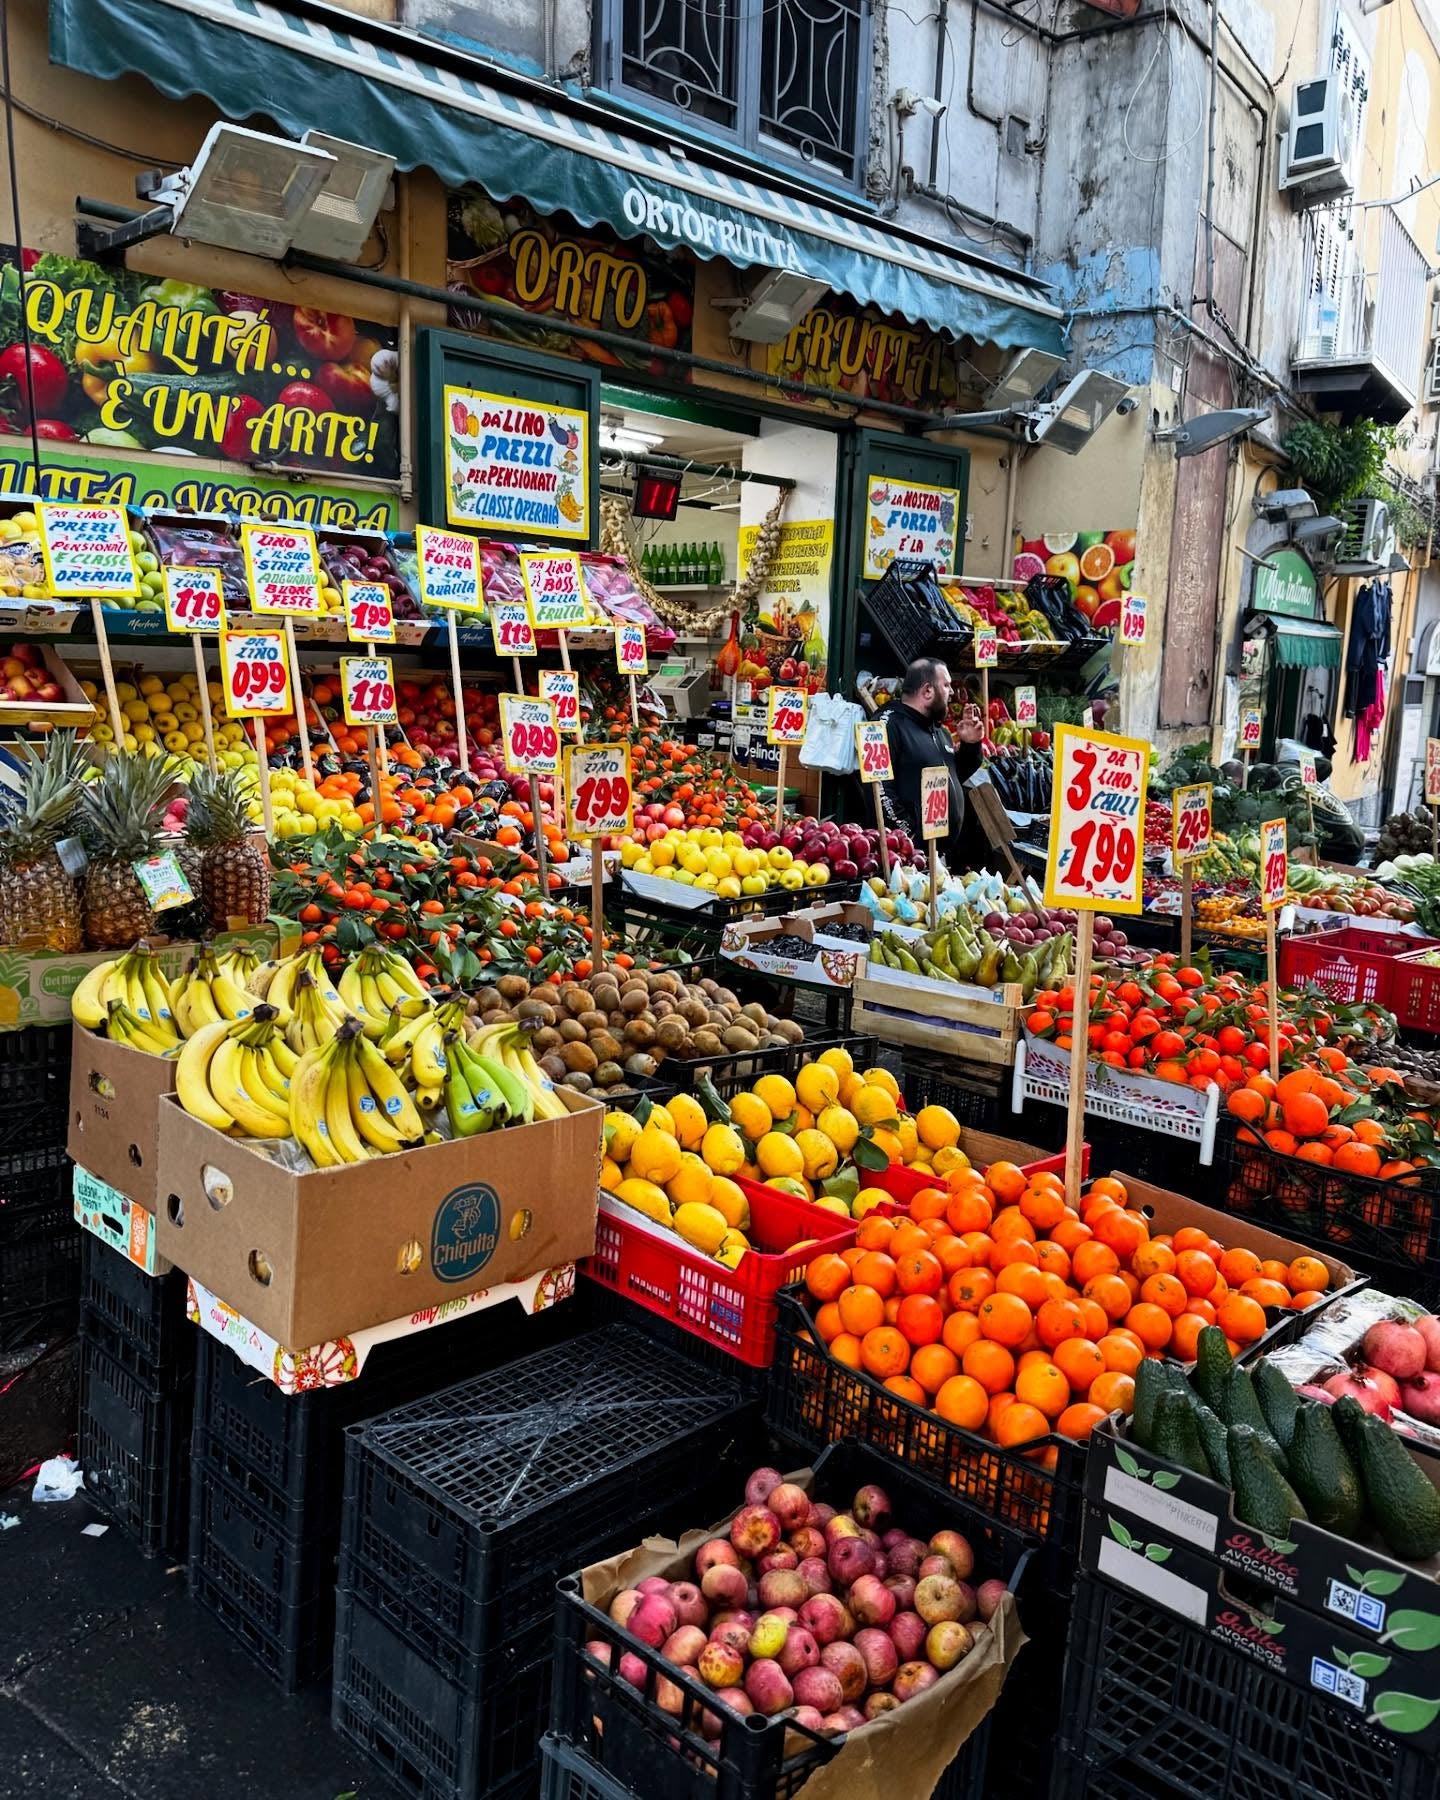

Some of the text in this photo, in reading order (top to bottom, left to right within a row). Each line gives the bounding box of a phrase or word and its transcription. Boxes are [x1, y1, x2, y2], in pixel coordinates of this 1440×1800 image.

[622, 188, 799, 272] ORTOFRUTTA
[510, 230, 648, 330] ORTO
[782, 307, 947, 394] FRUTTA
[481, 409, 545, 437] DA LINO
[481, 434, 554, 468] PREZZI
[467, 465, 557, 493] PER PENSIONATI
[476, 492, 513, 520] CLASSE
[514, 497, 560, 525] OPERAIA
[891, 491, 940, 513] LA NOSTRA
[74, 509, 108, 520] LINO
[49, 521, 116, 533] PREZZI
[887, 511, 937, 534] FORZA
[75, 533, 108, 542] PER
[258, 534, 296, 547] LINO
[425, 532, 474, 554] LA NOSTRA
[51, 540, 128, 552] PENSIONATI
[910, 539, 924, 553] LA
[69, 552, 130, 566] CLASSE
[288, 550, 311, 561] SUO
[425, 551, 473, 571] FORZA
[258, 561, 305, 573] STAFF
[529, 560, 545, 571] DA
[55, 568, 134, 584] OPERAIA
[445, 570, 462, 580] LA
[172, 577, 212, 590] LINO
[264, 584, 314, 595] BUONE
[543, 577, 576, 595] BOSS
[269, 594, 315, 608] FESTE
[350, 591, 385, 603] LINO
[540, 594, 577, 604] DELLA
[351, 602, 391, 631] 1,99
[500, 612, 526, 622] LINO
[536, 605, 585, 622] FRUTTA
[623, 632, 641, 642] LINO
[236, 646, 278, 660] LINO
[355, 668, 388, 680] LINO
[232, 662, 287, 701] 0,99
[547, 682, 574, 692] LINO
[778, 698, 804, 709] LINO
[519, 711, 549, 723] LINO
[864, 732, 884, 742] LINO
[1107, 751, 1127, 767] DA
[583, 760, 619, 774] LINO
[1067, 749, 1097, 811] 3
[1097, 768, 1132, 789] LINO
[575, 777, 631, 827] 1,99
[1183, 798, 1206, 809] LINO
[1060, 820, 1136, 892] 1,99
[433, 1231, 496, 1266] Chiquita
[1226, 1548, 1295, 1586] AVOCADOS
[1216, 1624, 1283, 1664] AVOCADOS
